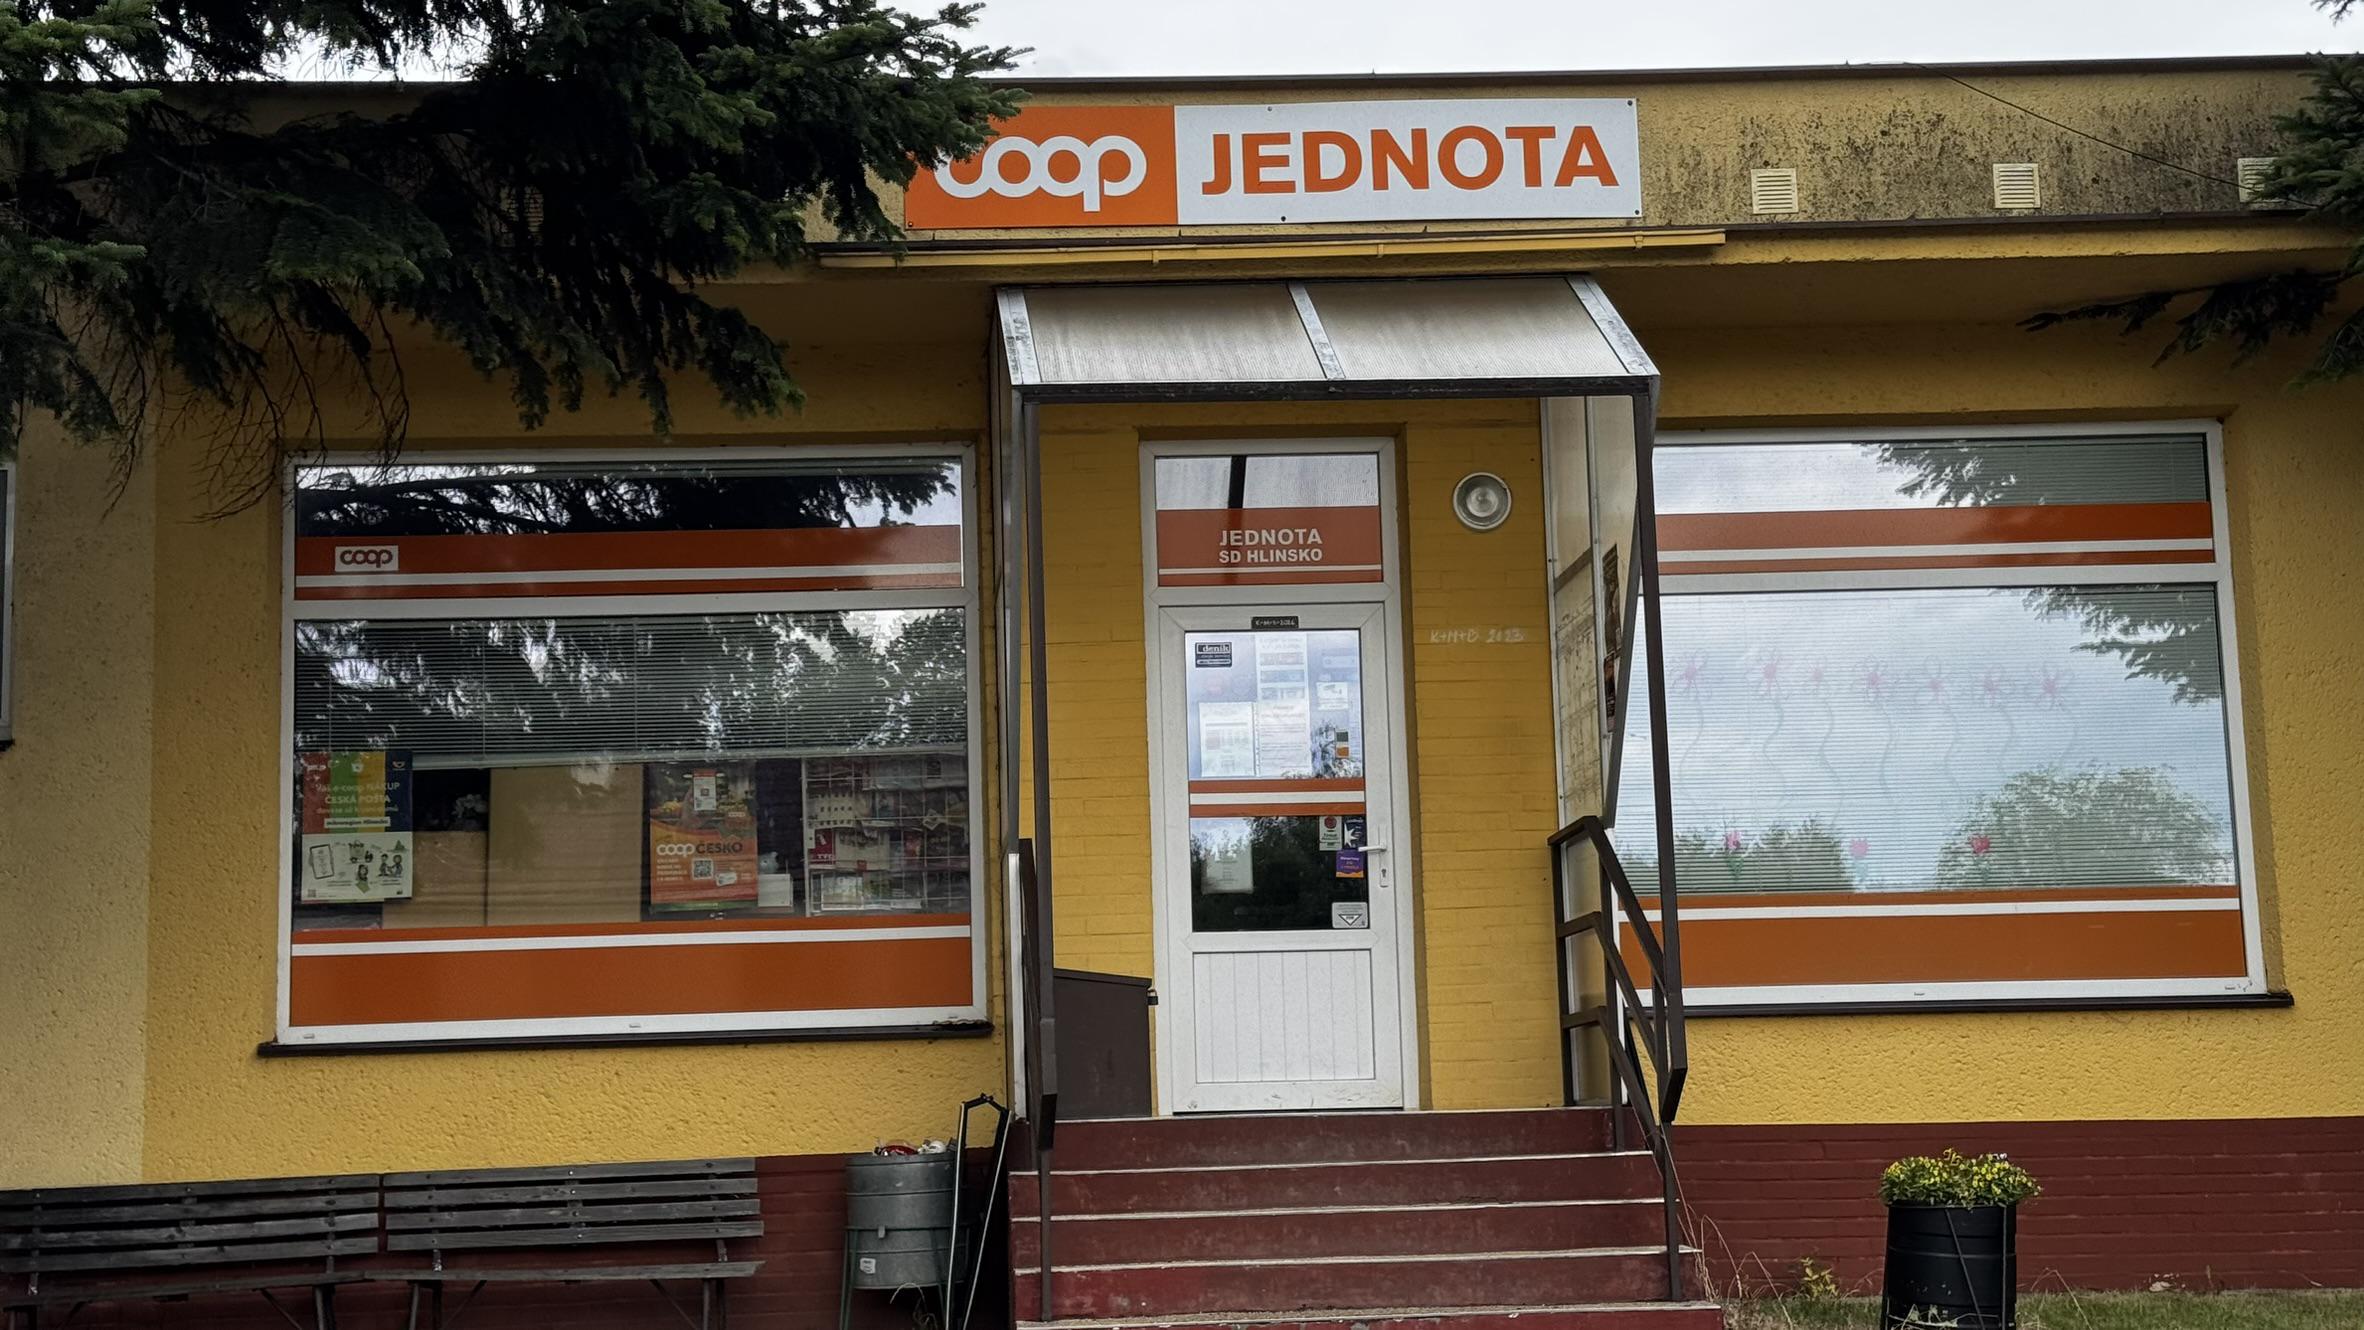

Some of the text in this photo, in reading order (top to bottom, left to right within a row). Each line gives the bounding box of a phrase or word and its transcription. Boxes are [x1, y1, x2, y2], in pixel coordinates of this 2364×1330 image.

[1202, 125, 1620, 195] JEDNOTA
[1219, 528, 1323, 547] JEDNOTA
[340, 549, 393, 568] coop
[1219, 548, 1323, 564] SD HLINSKO
[656, 843, 695, 858] coop
